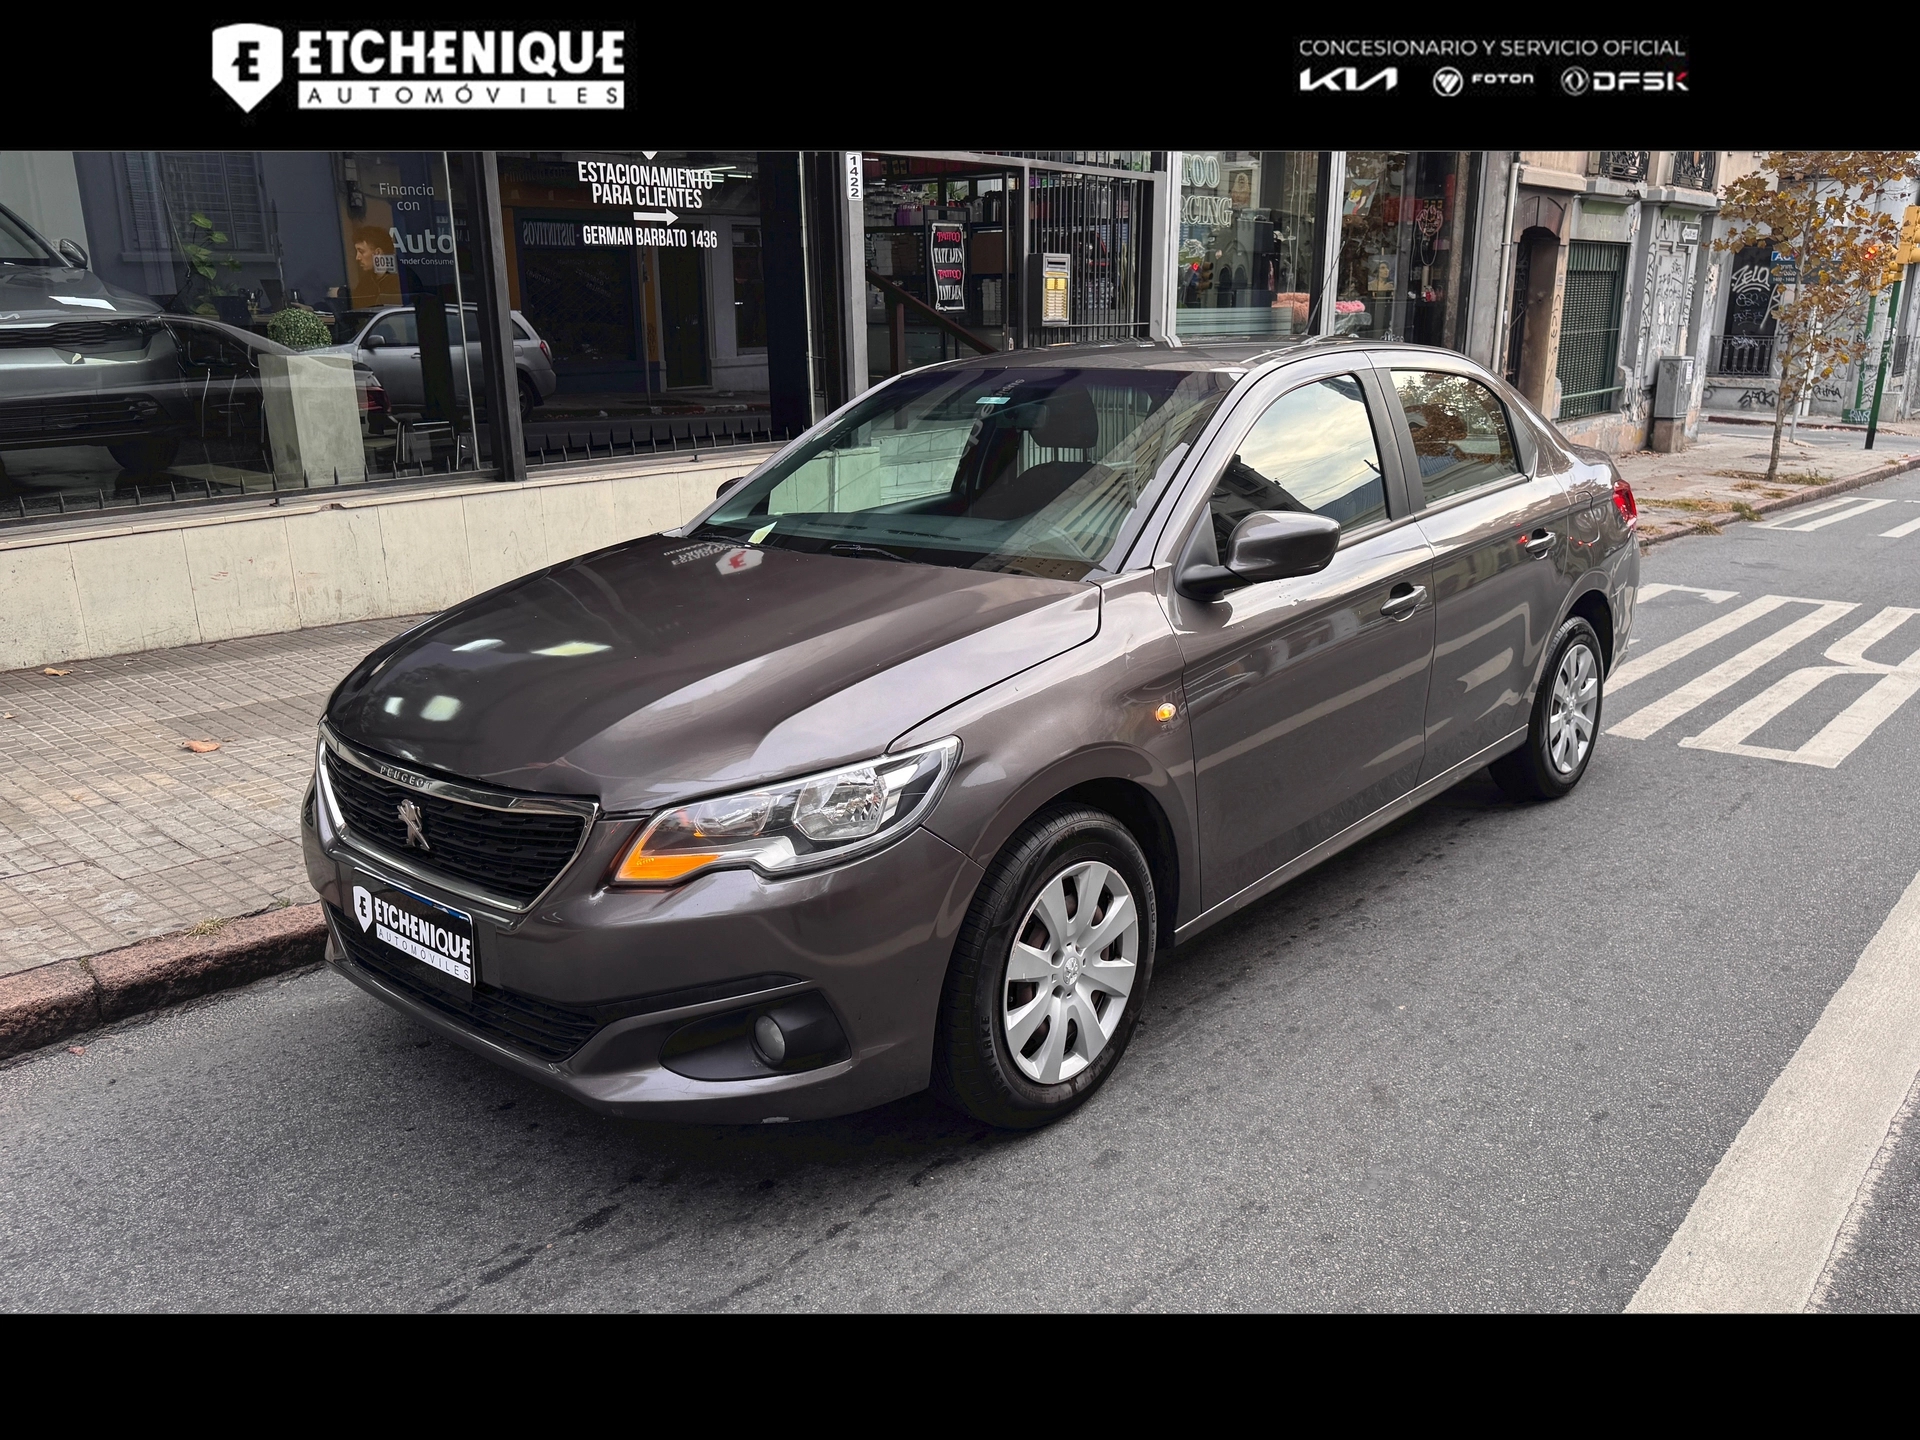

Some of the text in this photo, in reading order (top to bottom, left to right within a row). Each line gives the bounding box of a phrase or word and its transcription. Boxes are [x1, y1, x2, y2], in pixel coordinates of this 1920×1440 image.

[577, 160, 713, 190] ESTACIONAMIENTO
[849, 155, 860, 198] 1422
[379, 183, 435, 196] Financia
[592, 183, 703, 209] PARA CLIENTES
[396, 201, 420, 211] con
[389, 227, 454, 254] Auto
[582, 225, 718, 248] GERMAN BARBATO 1436
[379, 765, 433, 790] PEUGEOT
